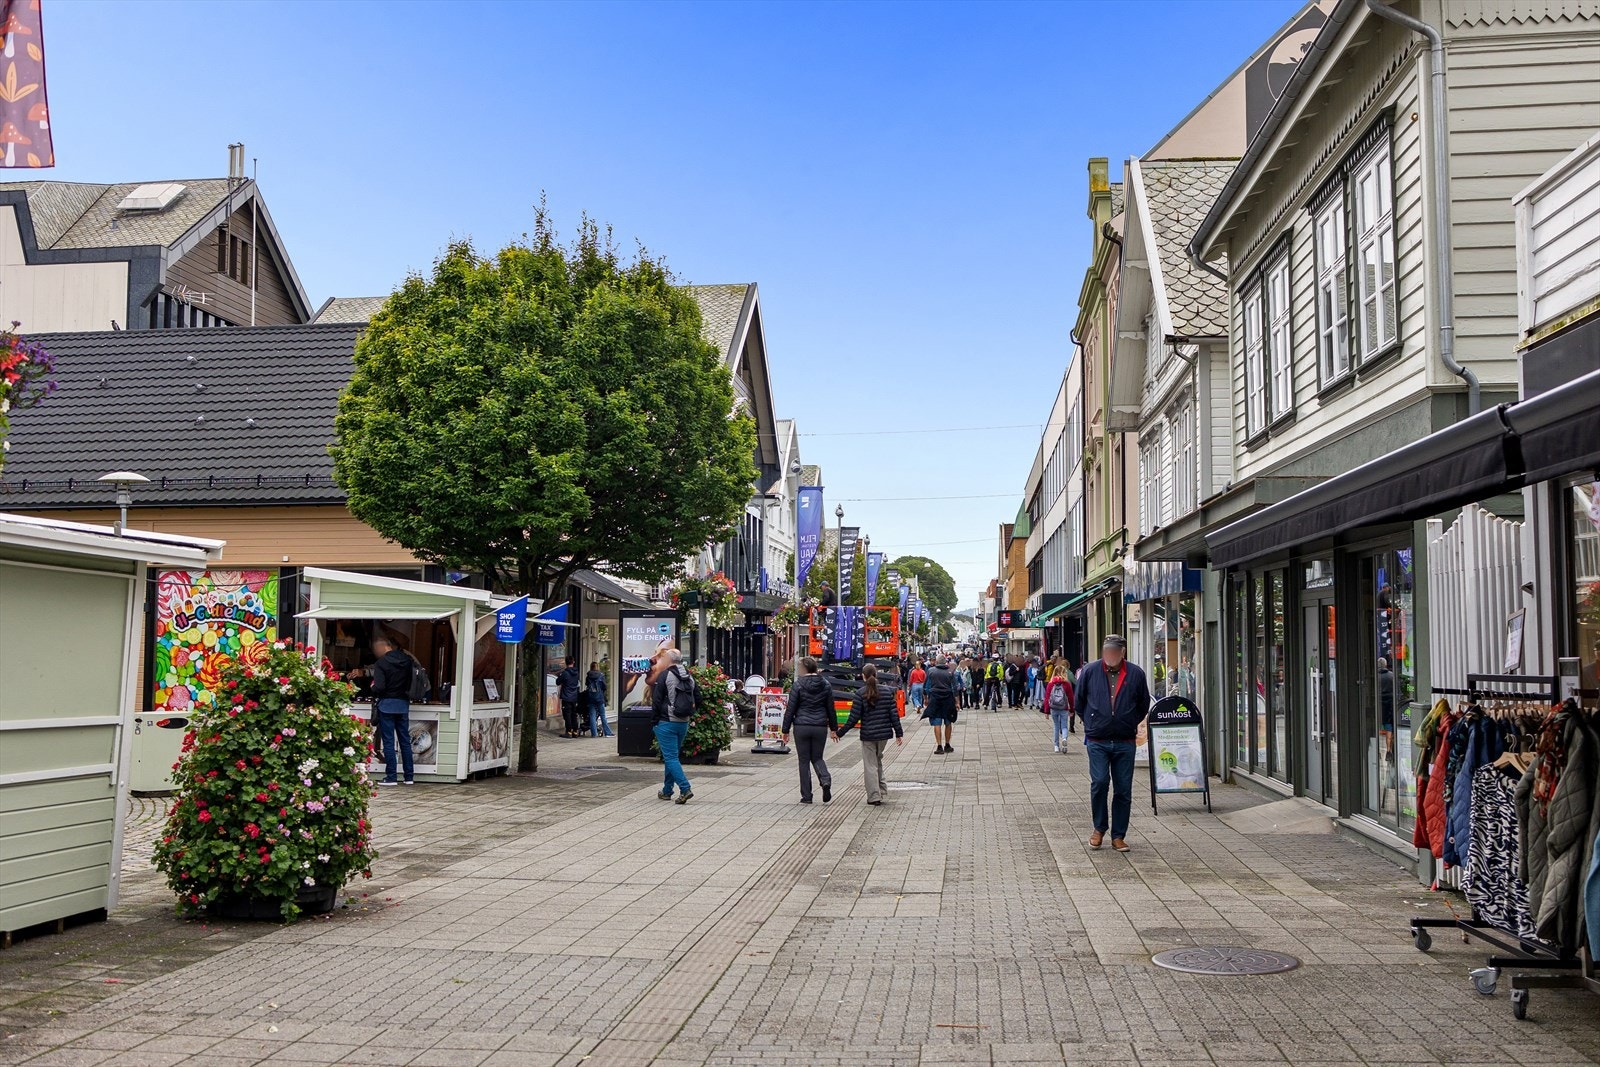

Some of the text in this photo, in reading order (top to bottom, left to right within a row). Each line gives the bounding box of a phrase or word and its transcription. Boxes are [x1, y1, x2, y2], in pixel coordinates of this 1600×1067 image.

[646, 626, 657, 634] PÅ
[764, 710, 782, 718] Åpent
[1157, 709, 1192, 719] sunkost
[1160, 757, 1174, 765] 119
